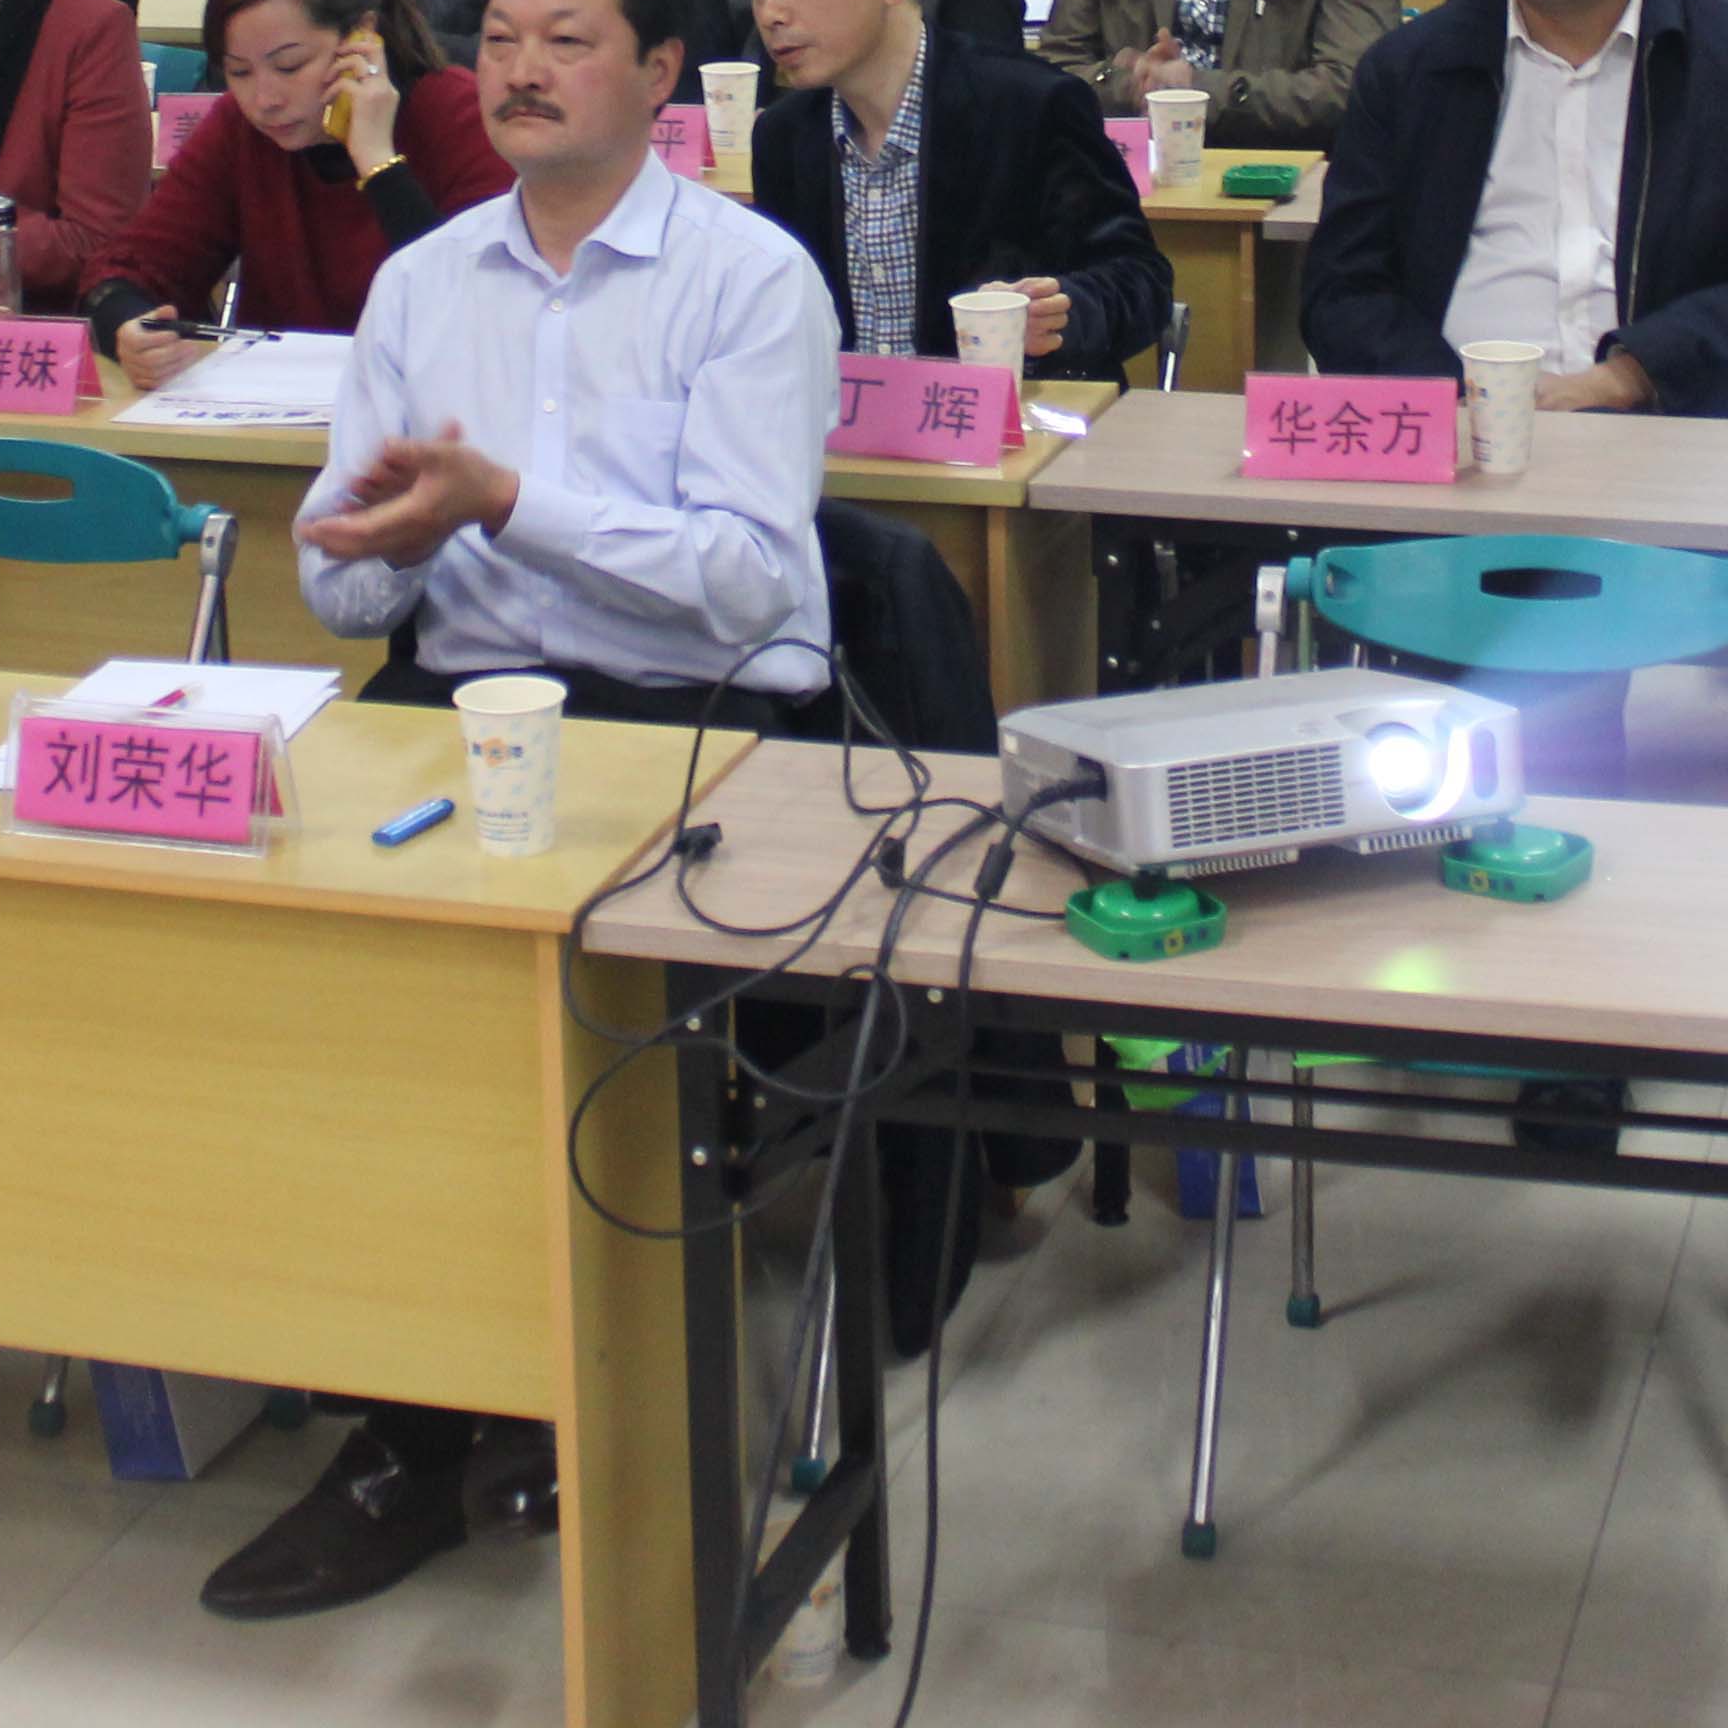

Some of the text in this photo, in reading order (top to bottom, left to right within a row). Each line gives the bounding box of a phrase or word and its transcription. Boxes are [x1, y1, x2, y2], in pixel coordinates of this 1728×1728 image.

[1269, 400, 1430, 456] 华余方
[43, 731, 232, 817] 刘荣华
